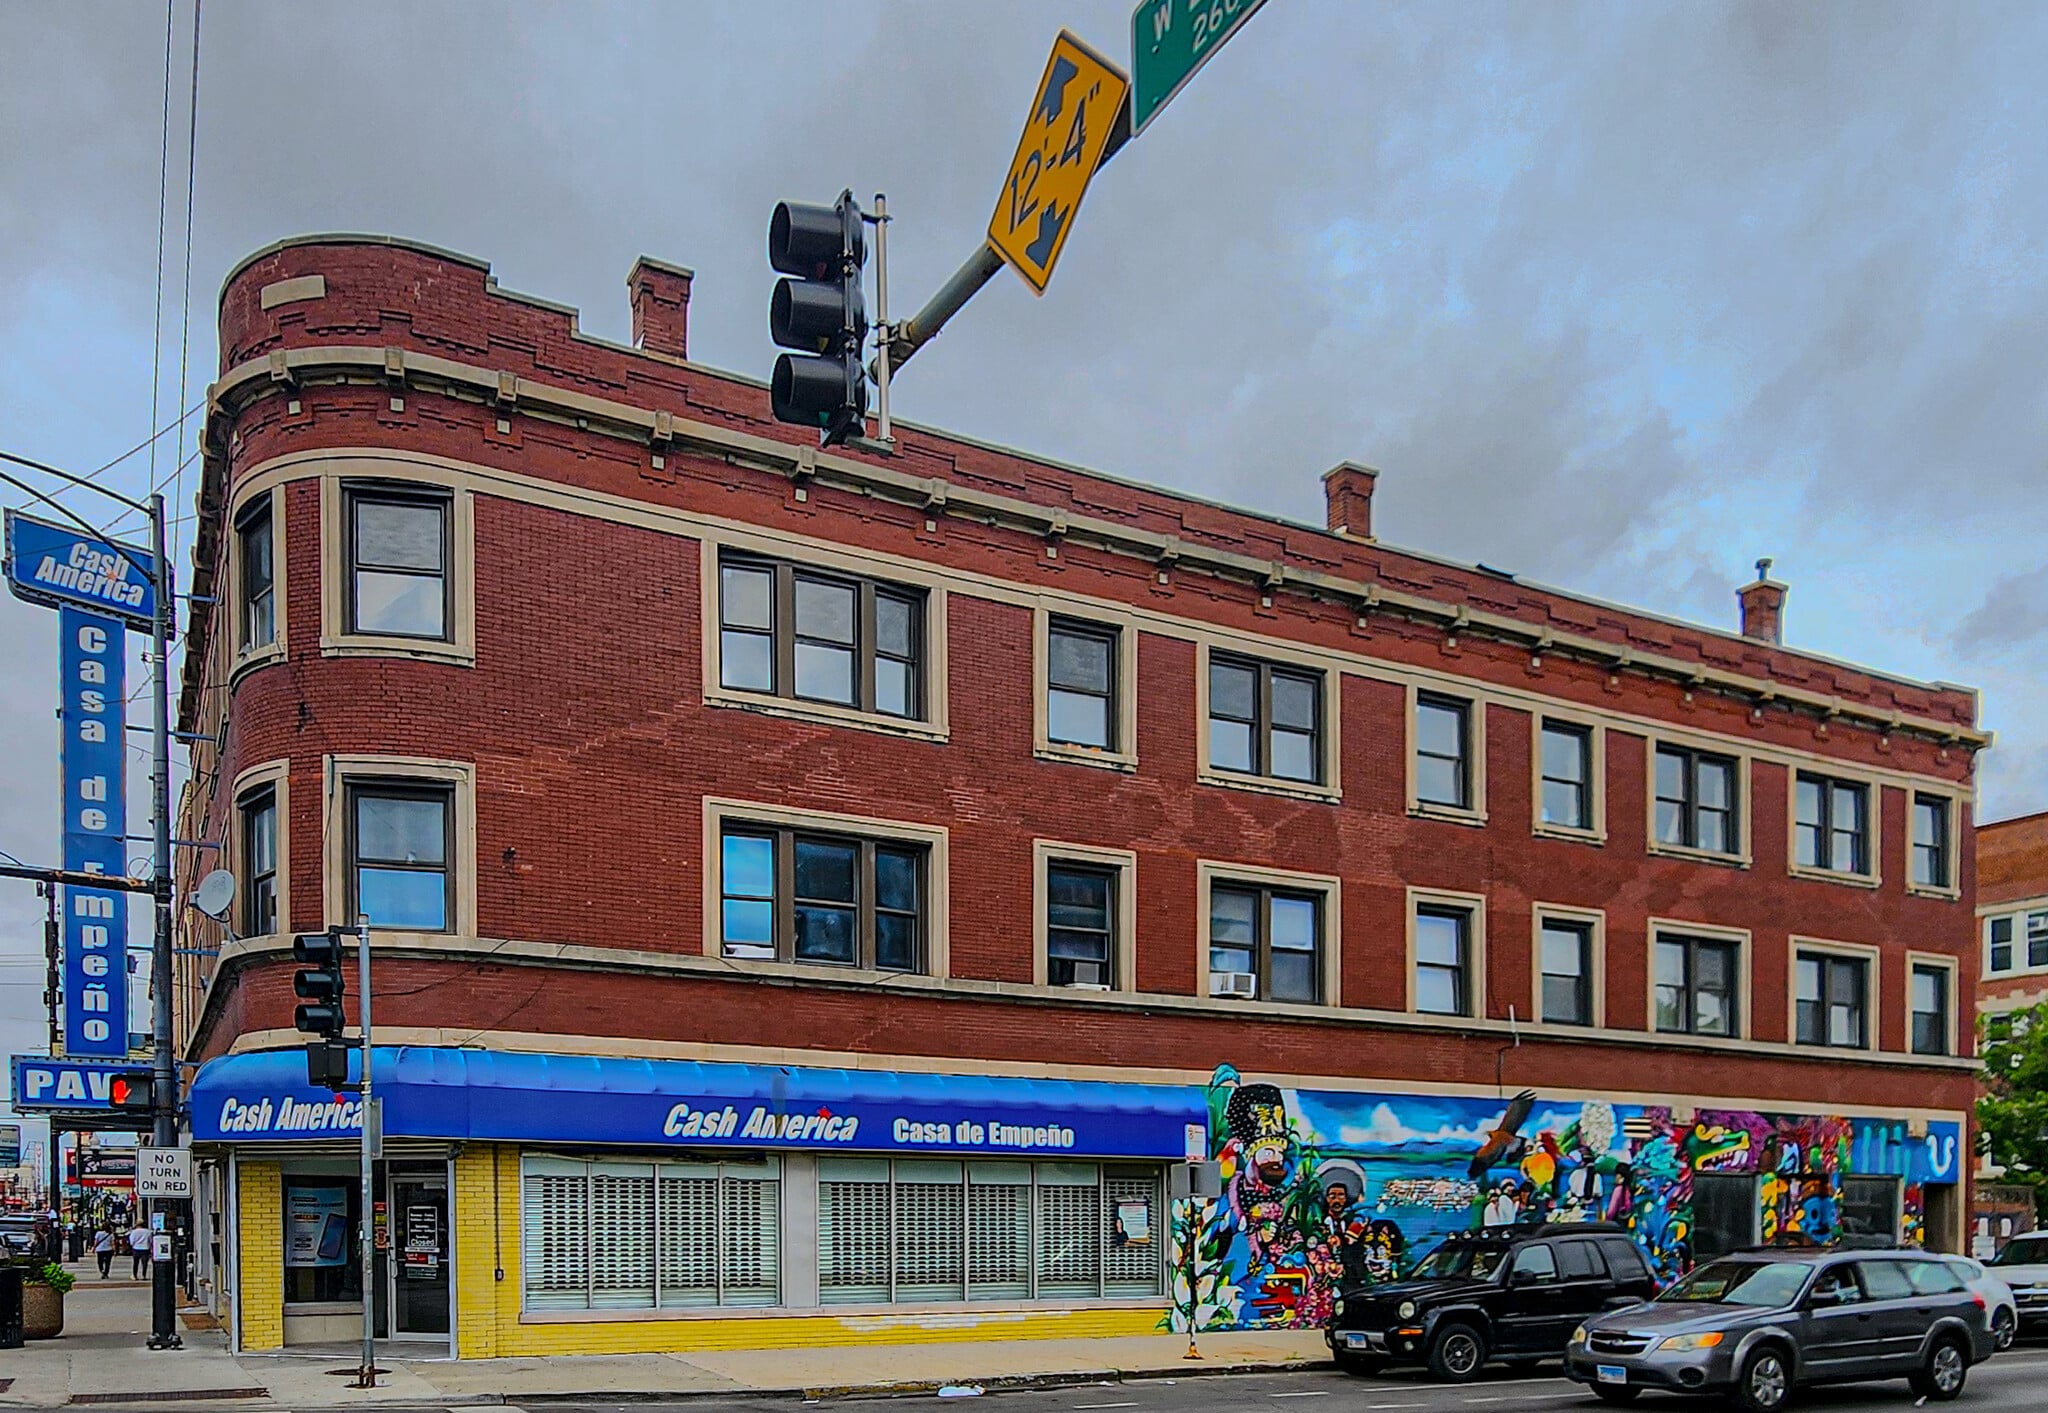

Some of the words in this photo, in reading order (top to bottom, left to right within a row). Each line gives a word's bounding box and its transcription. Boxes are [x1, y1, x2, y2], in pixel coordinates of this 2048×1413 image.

[1154, 0, 1173, 41] W
[69, 542, 130, 580] Cash
[34, 555, 145, 607] America
[78, 626, 107, 743] Casa
[80, 775, 107, 831] de
[26, 1069, 112, 1101] PAW
[219, 1098, 273, 1133] Cash
[274, 1095, 364, 1131] America
[663, 1103, 739, 1138] Cash
[739, 1107, 860, 1142] America
[893, 1117, 951, 1144] Casa
[956, 1120, 985, 1145] de
[988, 1121, 1075, 1149] Empeño
[149, 1167, 181, 1178] TURN
[154, 1153, 175, 1165] NO
[141, 1180, 158, 1191] ON
[164, 1181, 188, 1191] RED
